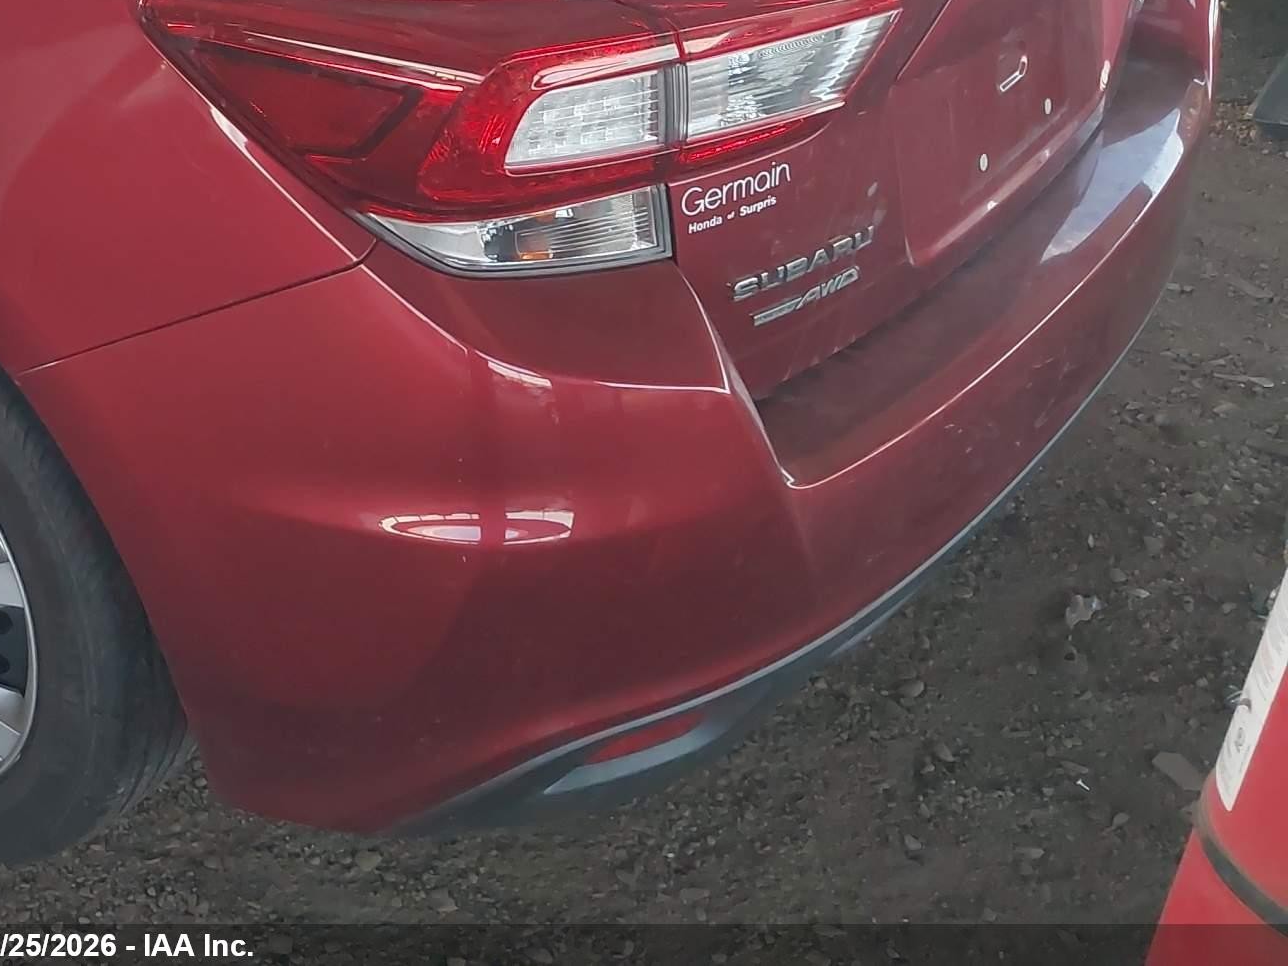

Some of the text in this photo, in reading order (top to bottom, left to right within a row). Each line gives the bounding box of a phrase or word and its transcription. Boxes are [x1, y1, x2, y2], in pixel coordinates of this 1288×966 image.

[681, 161, 792, 216] Germain
[688, 215, 723, 234] Honda
[733, 225, 875, 302] SUBARU
[795, 267, 860, 311] AWD
